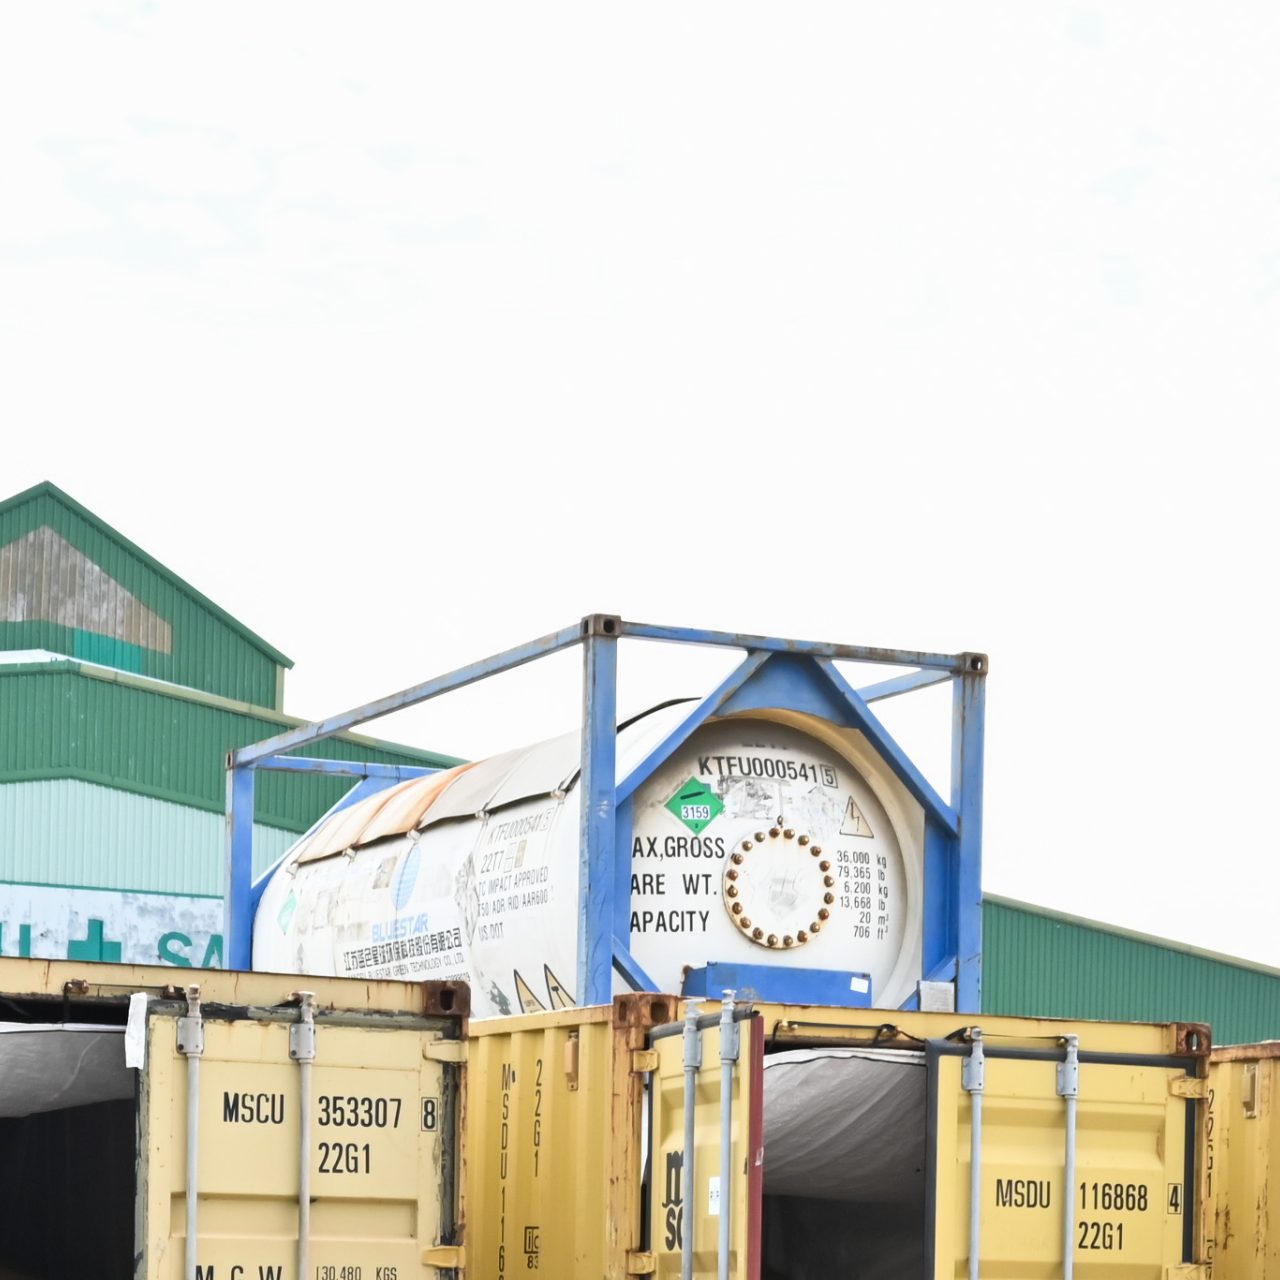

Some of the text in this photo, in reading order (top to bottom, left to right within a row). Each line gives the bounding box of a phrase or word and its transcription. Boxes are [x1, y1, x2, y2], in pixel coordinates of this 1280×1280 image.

[698, 756, 834, 785] KTFU000541 5
[682, 806, 709, 819] 3159
[877, 853, 887, 869] kg
[630, 873, 717, 895] ARE WT.
[878, 869, 885, 881] lb
[878, 884, 889, 899] kg
[878, 899, 886, 911] lb
[372, 913, 429, 942] BLUESTAR
[630, 910, 710, 932] APACITY
[859, 911, 871, 924] 20
[853, 925, 870, 938] 706
[223, 1092, 436, 1130] MSCU 353307 8
[500, 1063, 512, 1180] MSDU
[533, 1057, 543, 1177] 22G1
[318, 1142, 371, 1174] 22G1
[995, 1179, 1180, 1213] MSDU 116868 4
[1078, 1221, 1124, 1250] 22G1
